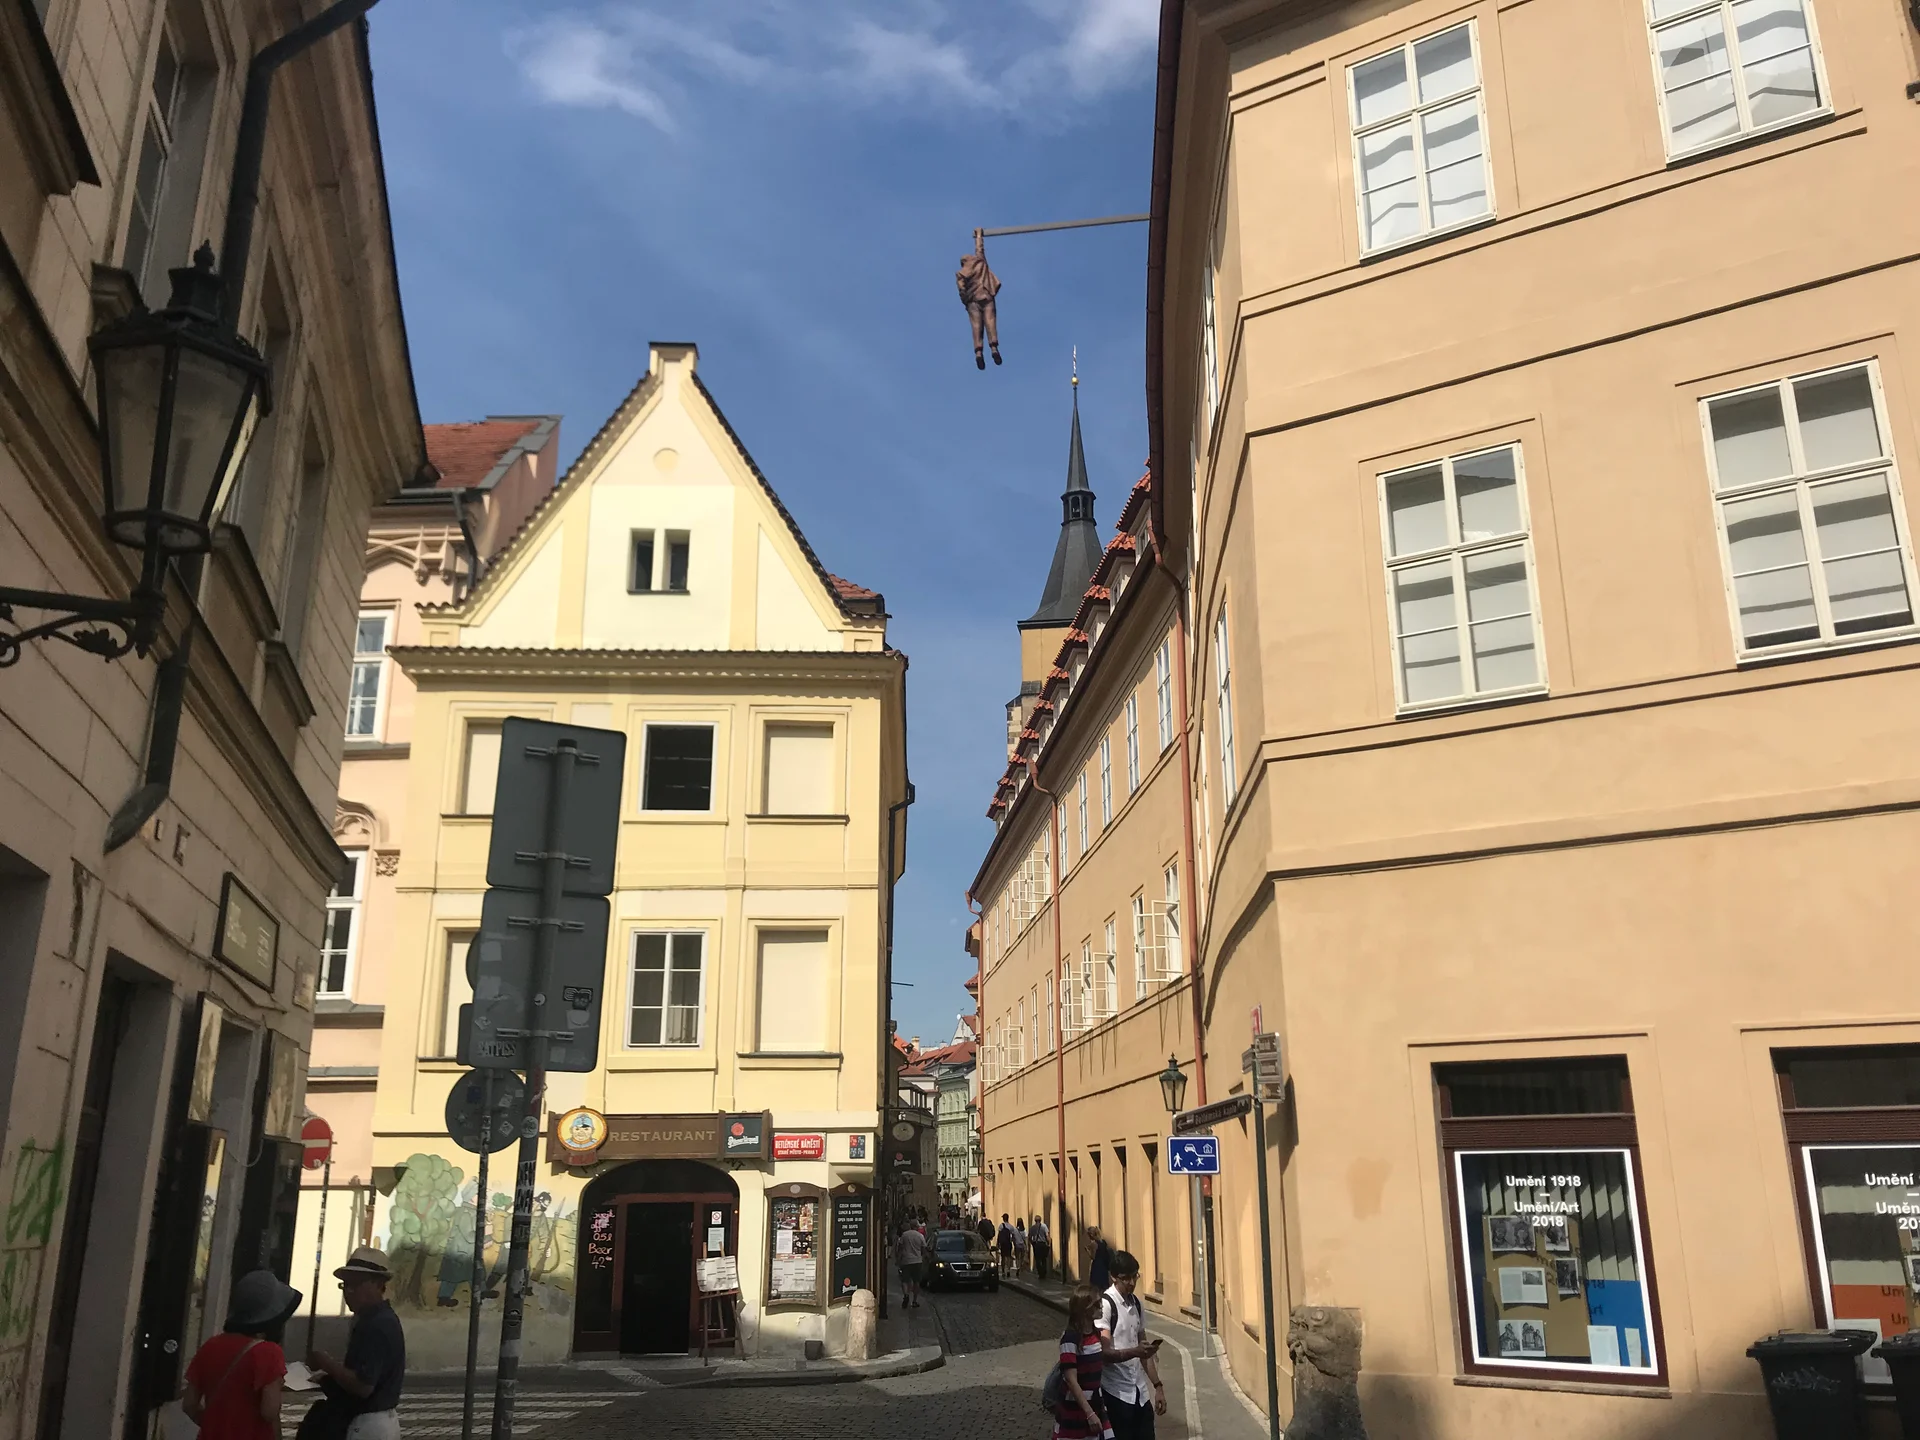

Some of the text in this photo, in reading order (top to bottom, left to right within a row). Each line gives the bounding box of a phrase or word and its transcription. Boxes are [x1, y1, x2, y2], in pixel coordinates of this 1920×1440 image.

[609, 1130, 716, 1142] RESTAURANT
[1506, 1175, 1581, 1187] Umění 1918
[1865, 1173, 1914, 1186] Umění
[1514, 1201, 1580, 1213] Umění/Art
[1532, 1215, 1564, 1227] 2018
[588, 1242, 613, 1255] Beer
